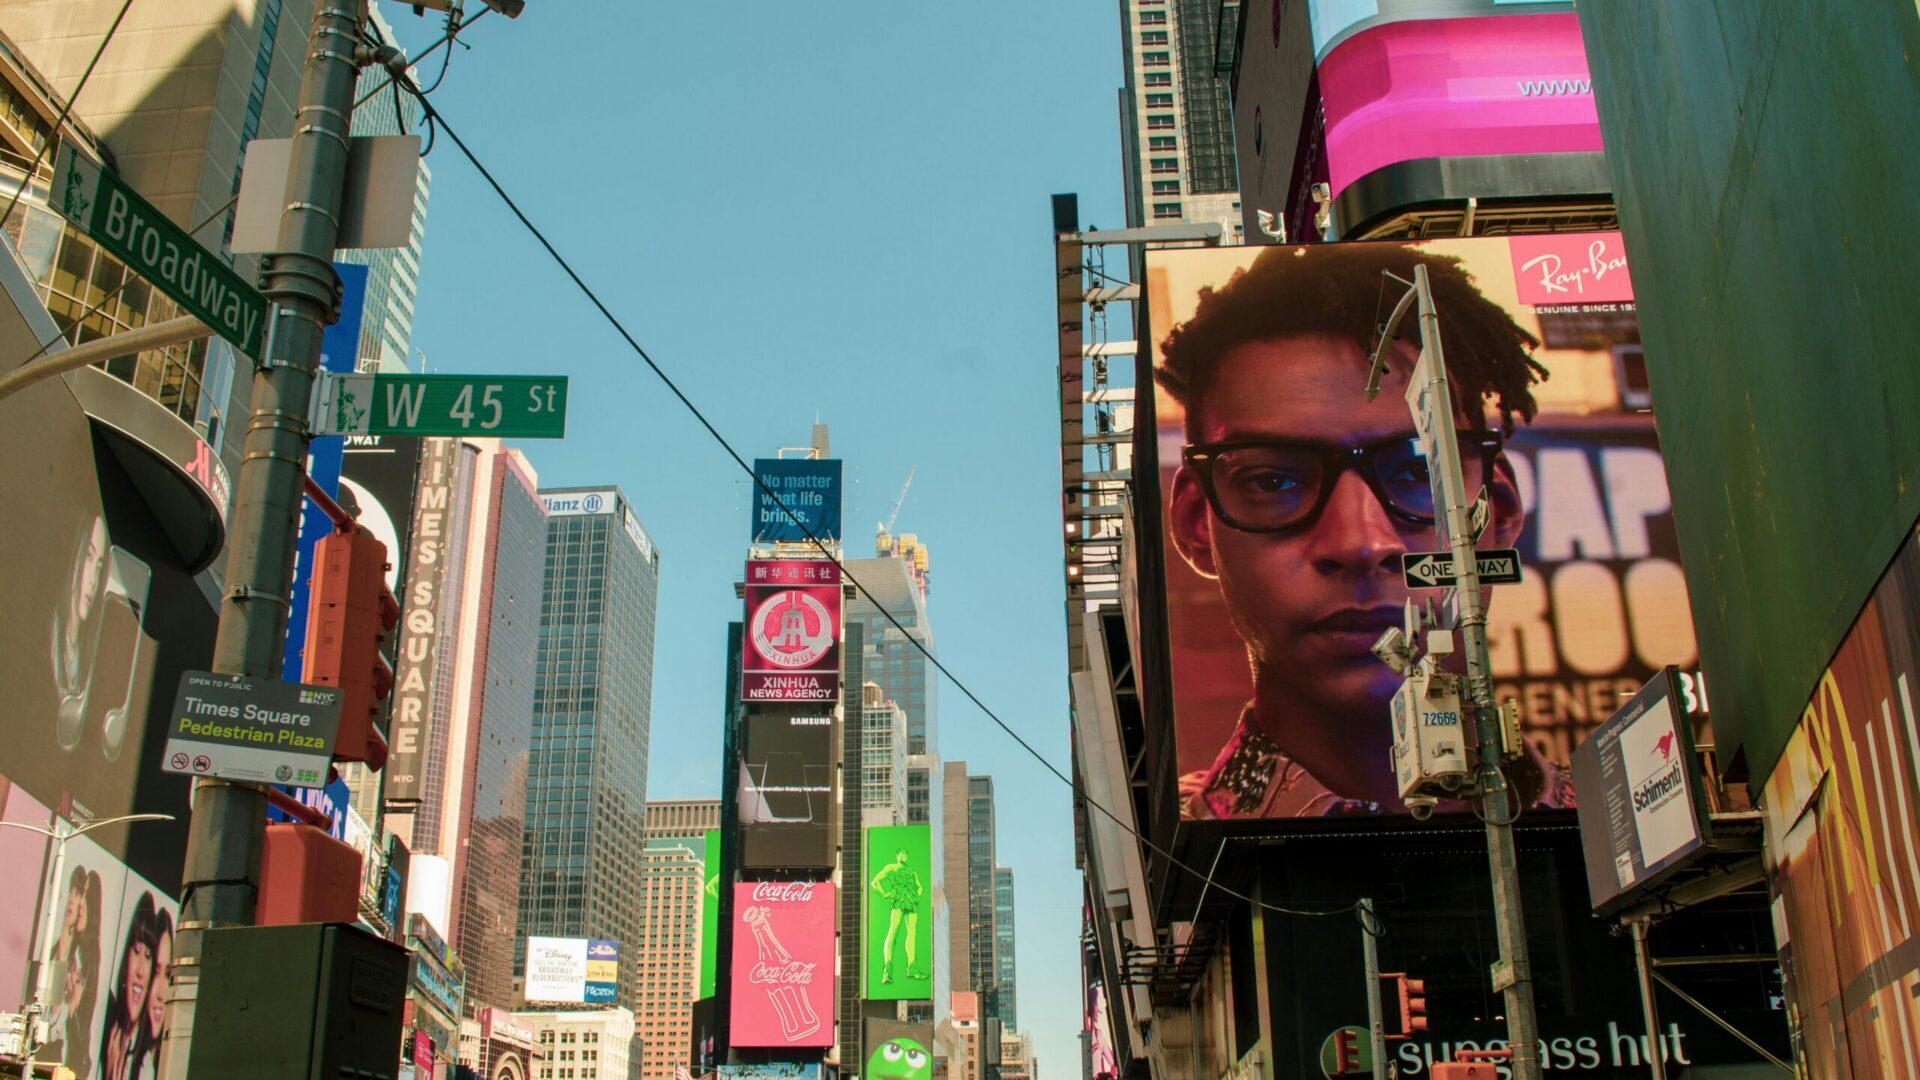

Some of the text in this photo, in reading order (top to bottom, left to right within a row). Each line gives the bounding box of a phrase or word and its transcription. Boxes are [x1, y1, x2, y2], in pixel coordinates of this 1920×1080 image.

[105, 188, 258, 350] Broadway
[1521, 240, 1628, 293] Ray-Ba
[1528, 306, 1580, 315] GENUINE
[1582, 304, 1617, 313] SINCE
[386, 384, 557, 429] W 45 St
[762, 474, 832, 488] No matter
[761, 491, 823, 506] what life
[760, 508, 810, 525] brings.
[755, 567, 831, 579] 新华通讯社
[1420, 562, 1454, 577] ONE
[396, 437, 453, 754] TIMES SQUARE
[770, 650, 817, 665] XINHUA
[189, 677, 253, 691] OPEN TO PUBLIC
[763, 677, 819, 688] XINHUA
[313, 691, 336, 702] NYC
[750, 689, 831, 698] NEWS AGENCY
[185, 697, 311, 727] Times Square
[1423, 712, 1457, 726] 72669
[791, 717, 831, 726] SAMSUNG
[178, 718, 325, 749] Pedestrian Plaza
[393, 775, 414, 783] NYC
[1633, 762, 1682, 812] Schimenti
[752, 881, 816, 901] Coca-Cola
[749, 962, 817, 984] Coca-Cola
[585, 985, 615, 997] FROZEN
[1399, 1021, 1691, 1080] sungass hut
